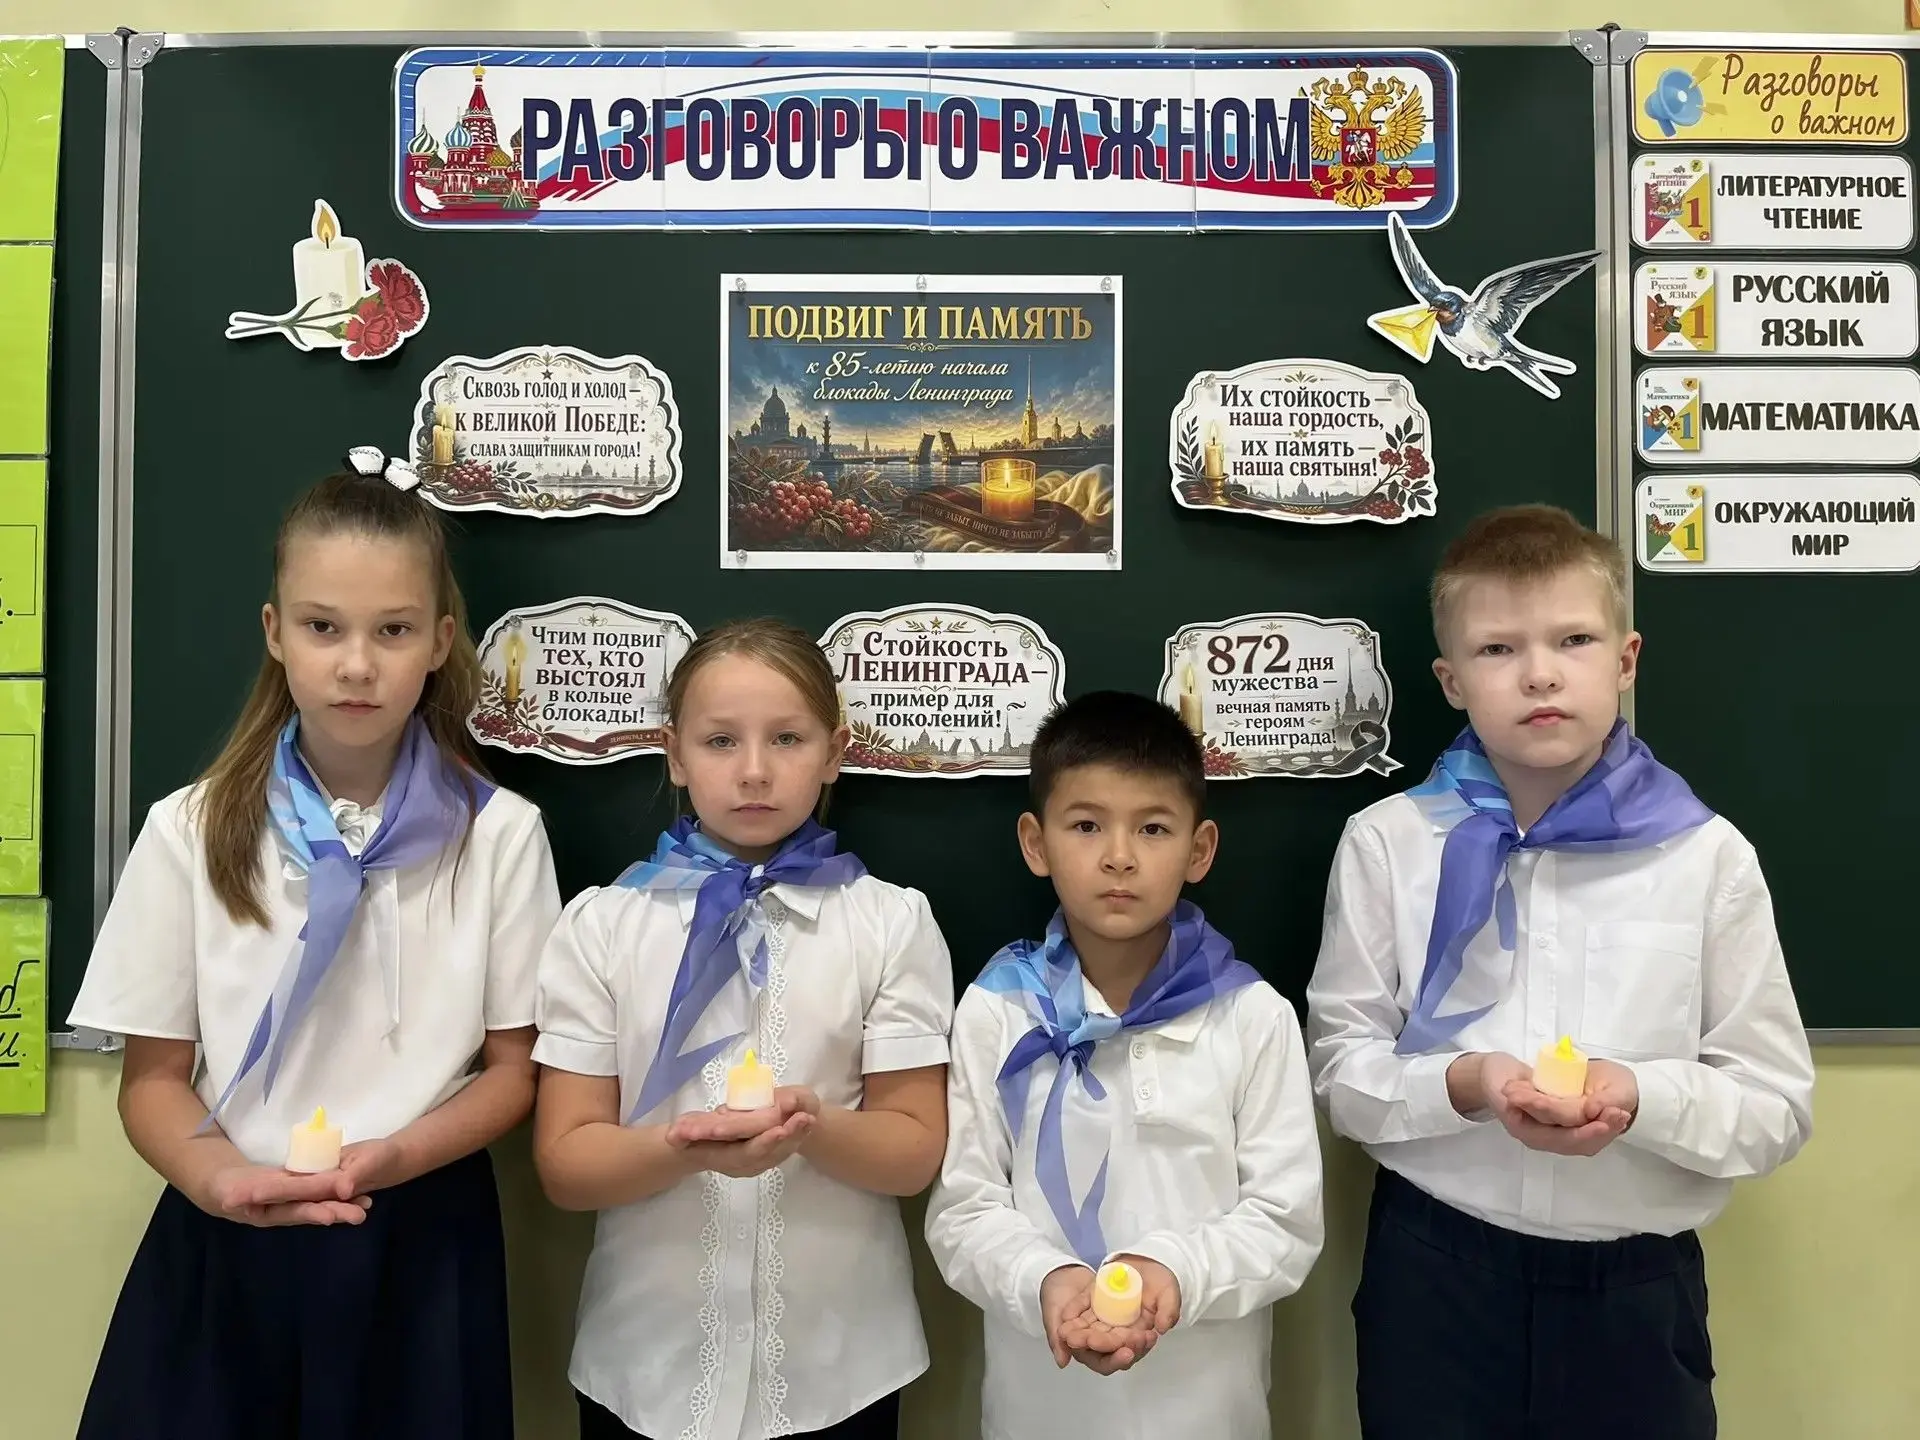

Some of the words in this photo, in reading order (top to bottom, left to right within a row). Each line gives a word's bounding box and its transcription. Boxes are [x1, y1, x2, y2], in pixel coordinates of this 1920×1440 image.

[1722, 53, 1879, 112] Разговоры
[1771, 114, 1784, 134] о
[1799, 99, 1895, 135] важном
[521, 97, 923, 181] РАЗГОВОРЫ
[938, 97, 978, 181] О
[1001, 97, 1311, 181] ВАЖНОМ
[1717, 175, 1907, 198] ЛИТЕРАТУРНОЕ
[1686, 197, 1703, 228] 1
[1763, 208, 1862, 230] ЧТЕНИЕ
[1650, 280, 1687, 291] Русский
[1669, 291, 1697, 299] ЯЗЫК
[1732, 271, 1890, 304] РУССКИЙ
[748, 305, 892, 344] ПОДВИГ
[903, 305, 927, 340] И
[938, 306, 1094, 341] ПАМЯТЬ
[1689, 304, 1708, 338] 1
[1761, 318, 1864, 347] ЯЗЫК
[806, 362, 818, 375] к
[825, 351, 936, 378] 85-летию
[941, 362, 1009, 376] начала
[813, 378, 891, 402] блокады
[894, 386, 1014, 409] Ленинграда
[1220, 384, 1254, 407] Их
[1260, 387, 1371, 408] стойкость
[1228, 411, 1283, 426] наша
[1289, 412, 1384, 431] гордость,
[1679, 412, 1694, 439] 1
[1701, 402, 1919, 431] МАТЕМАТИКА
[470, 443, 506, 457] СЛАВА
[509, 444, 590, 458] ЗАЩИТНИКАМ
[594, 441, 641, 458] ГОРОДА!
[1241, 440, 1268, 457] их
[1275, 440, 1355, 457] память
[1232, 461, 1284, 476] наша
[1289, 457, 1378, 477] святыня!
[1714, 497, 1915, 526] ОКРУЖАЮЩИЙ
[1683, 522, 1699, 550] 1
[1792, 535, 1849, 556] МИР
[531, 625, 585, 645] Чтим
[592, 632, 665, 649] подвиг
[543, 648, 593, 669] тех,
[600, 651, 644, 667] кто
[1207, 634, 1291, 675] 872
[1296, 656, 1335, 673] дня
[535, 668, 646, 689] выстоял
[1212, 675, 1319, 696] мужества
[549, 690, 559, 702] в
[565, 690, 632, 706] кольце
[870, 693, 949, 711] пример
[954, 694, 994, 709] для
[1216, 702, 1271, 714] вечная
[1275, 700, 1330, 713] память
[542, 703, 645, 724] блокады!
[875, 709, 1001, 728] поколений!
[1245, 717, 1305, 731] героям
[1221, 729, 1337, 748] Ленинграда!
